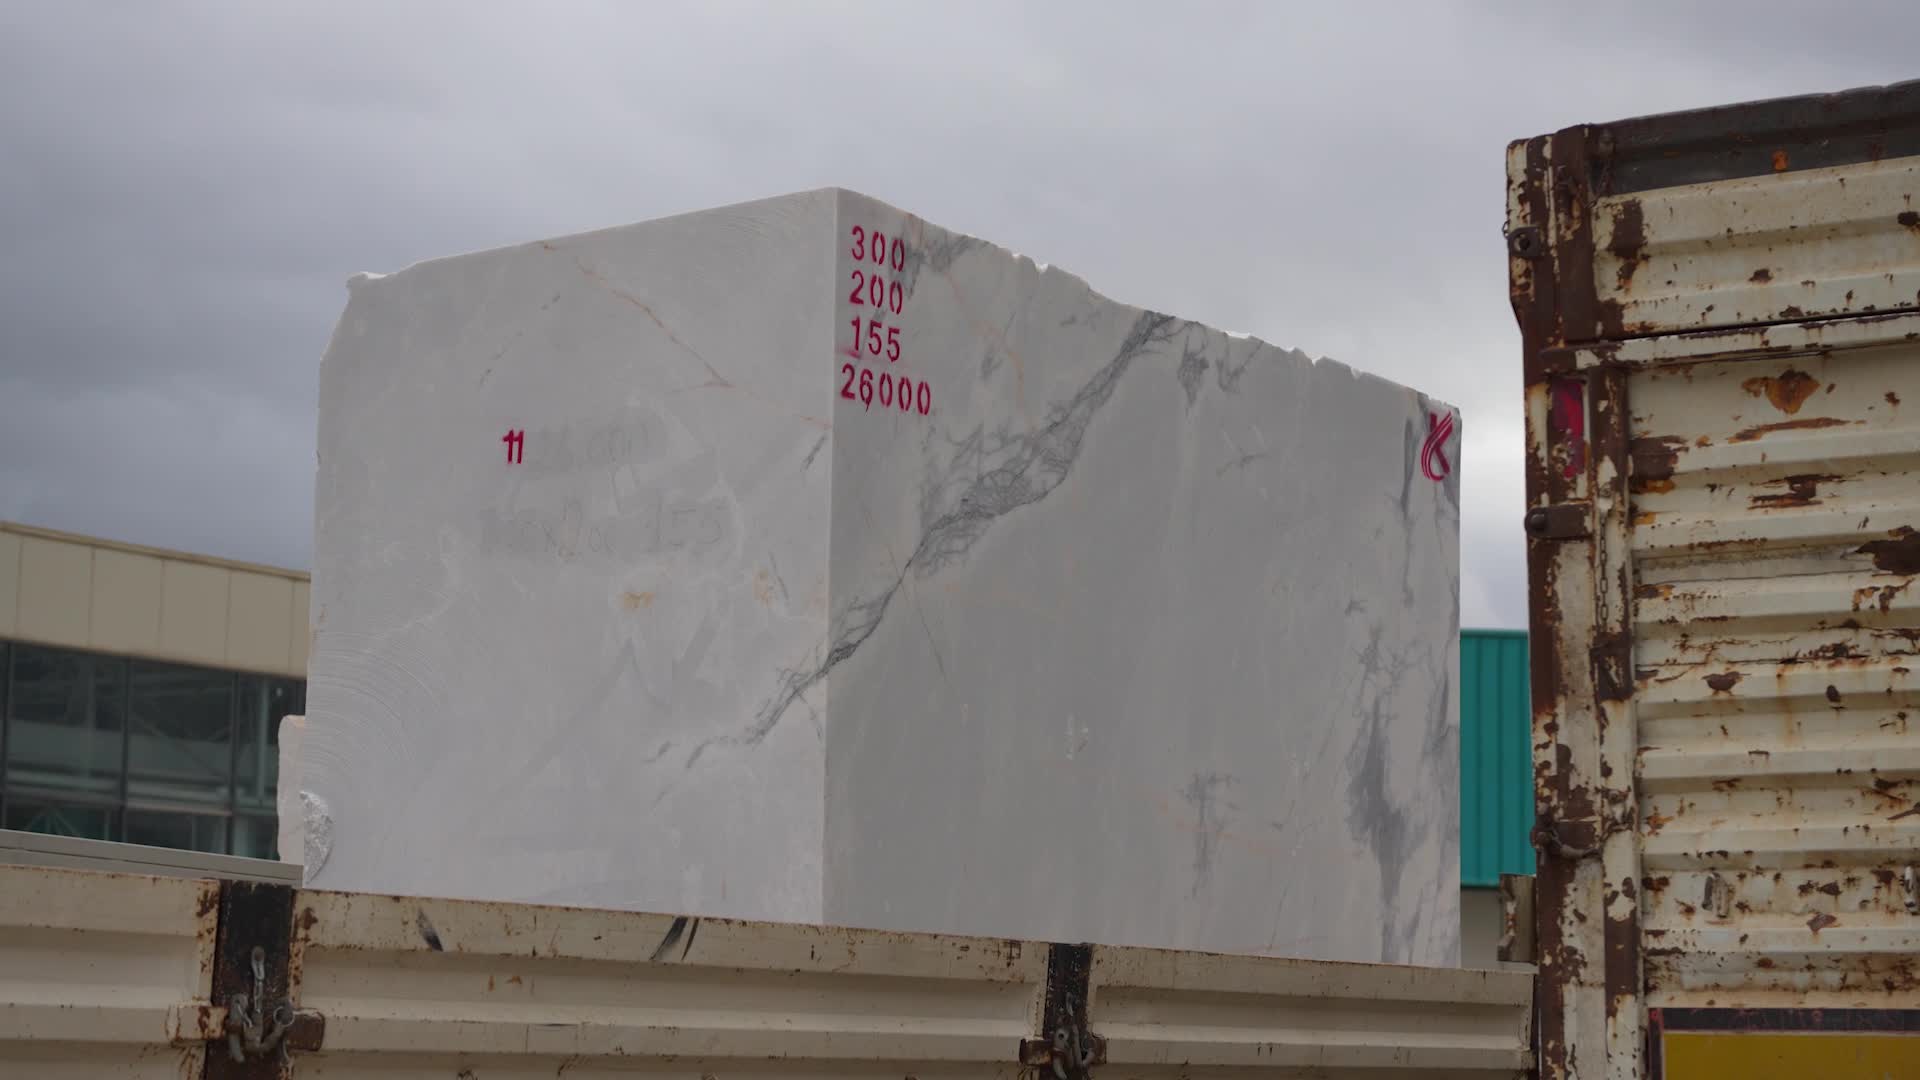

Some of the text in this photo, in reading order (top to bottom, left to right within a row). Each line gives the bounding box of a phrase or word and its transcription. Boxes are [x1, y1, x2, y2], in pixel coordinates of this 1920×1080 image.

[851, 225, 905, 272] 300
[849, 269, 903, 314] 200
[850, 316, 901, 363] 155
[841, 362, 931, 416] 26000
[502, 429, 525, 464] 11
